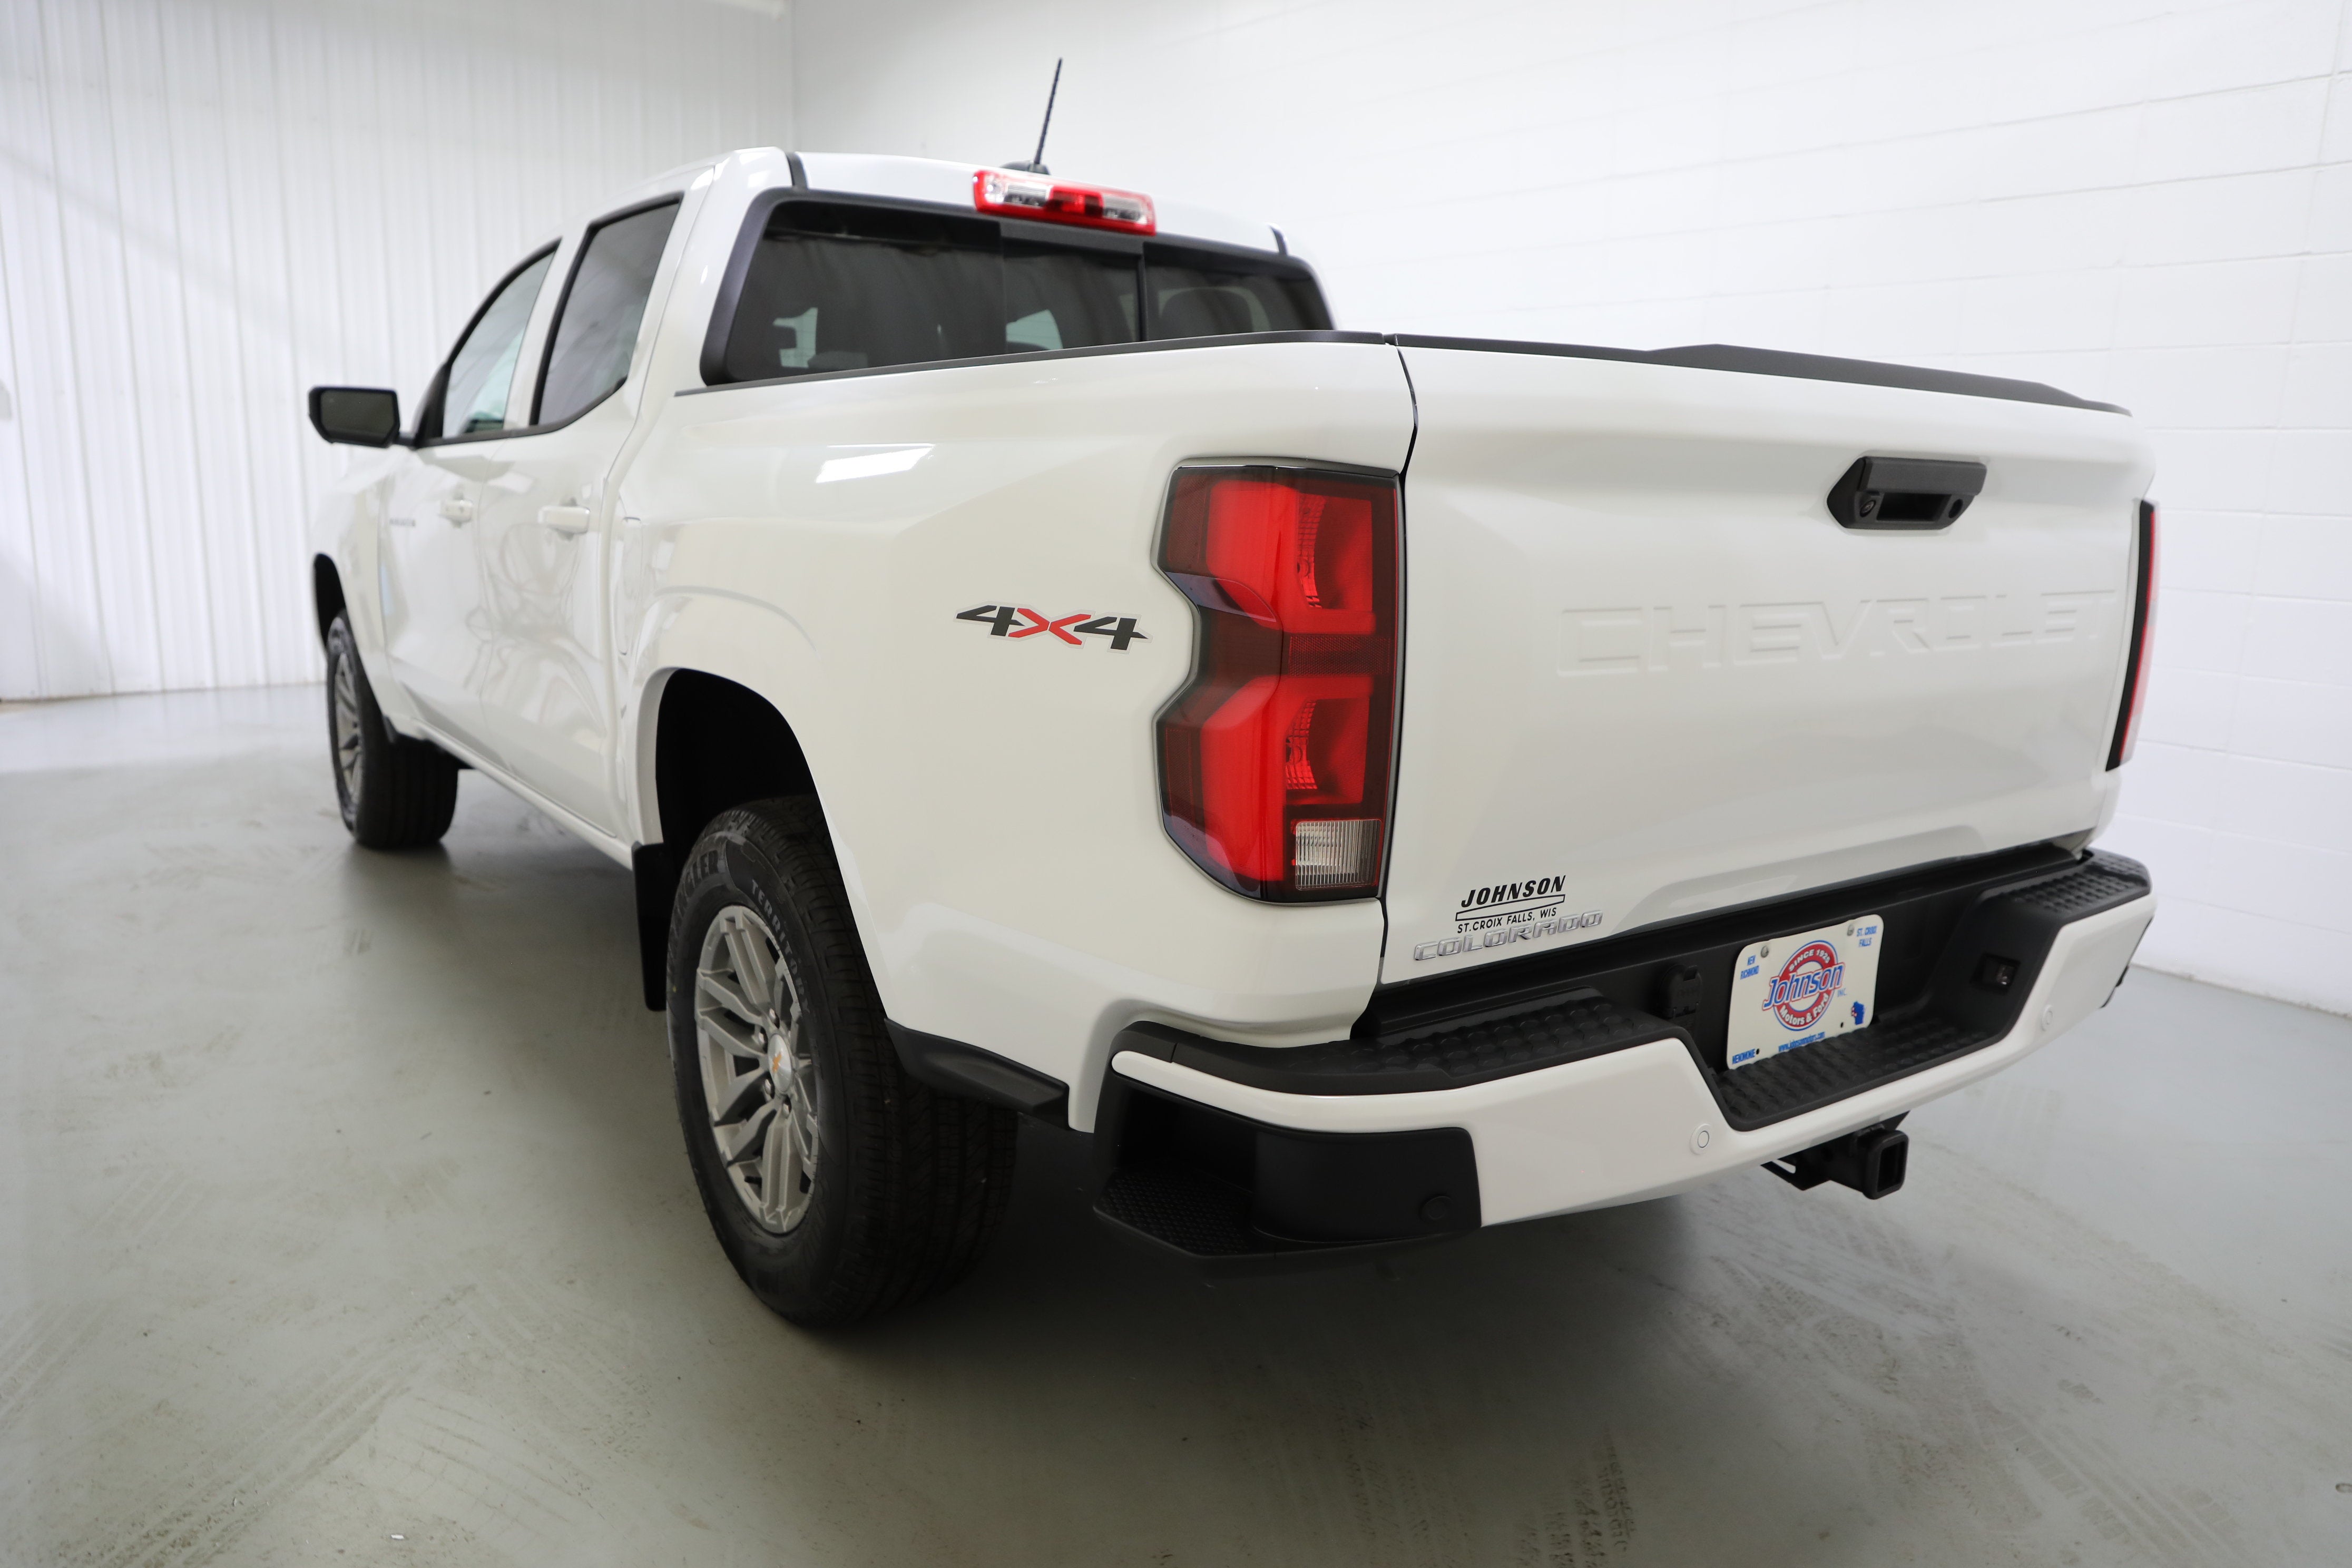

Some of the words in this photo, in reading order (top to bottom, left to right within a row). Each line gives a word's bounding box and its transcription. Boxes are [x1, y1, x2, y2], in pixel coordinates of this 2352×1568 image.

[1556, 589, 2117, 677] CHEVROLET
[1461, 875, 1566, 908] JOHNSON
[1413, 909, 1603, 962] COLORADO
[1506, 912, 1535, 926] FALLS,
[1540, 907, 1556, 918] WIS
[751, 878, 810, 1015] TERRITORY
[1789, 949, 1815, 972] SINCE
[1763, 964, 1845, 1008] Johnson
[1779, 1005, 1805, 1025] Motors
[1806, 1014, 1813, 1023] &
[1812, 993, 1830, 1017] Ford
